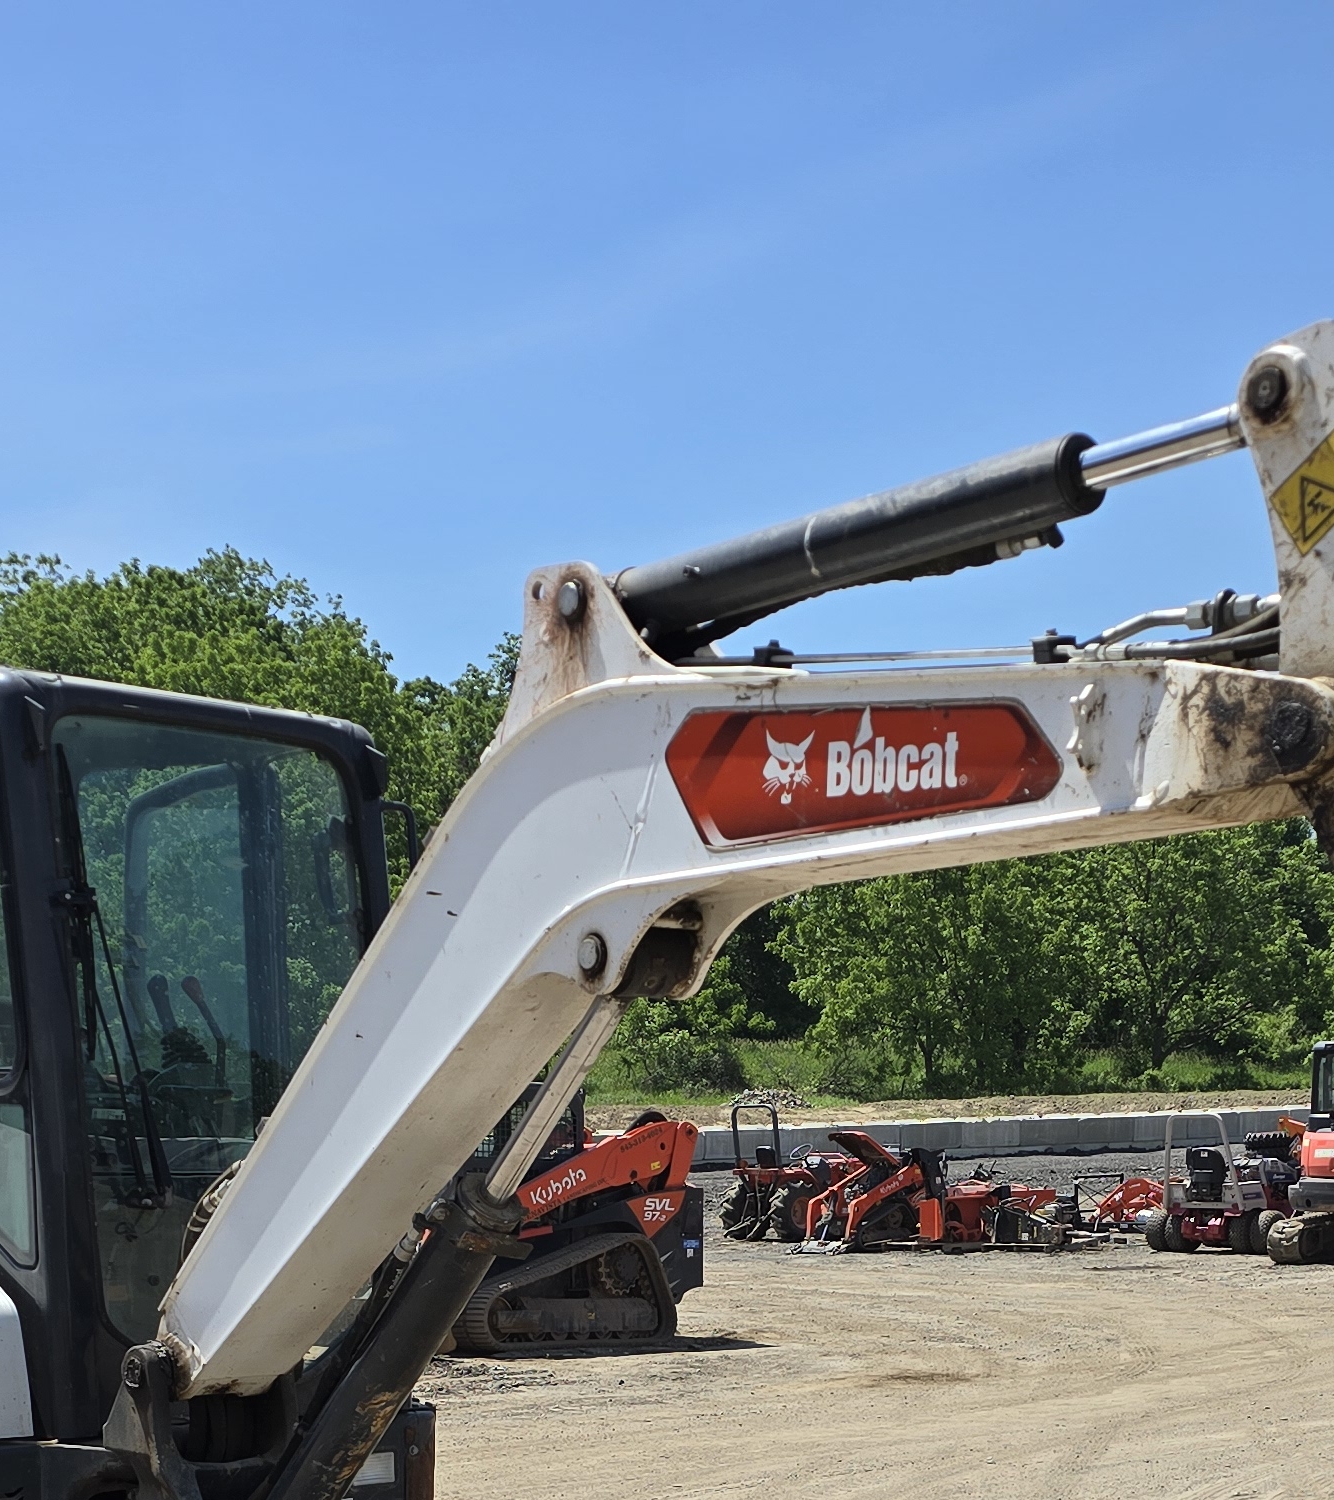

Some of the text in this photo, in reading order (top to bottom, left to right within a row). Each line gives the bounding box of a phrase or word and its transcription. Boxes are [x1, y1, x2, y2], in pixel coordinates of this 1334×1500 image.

[826, 731, 959, 797] Bobcat
[530, 1168, 587, 1205] Kubota
[643, 1198, 675, 1210] SVL
